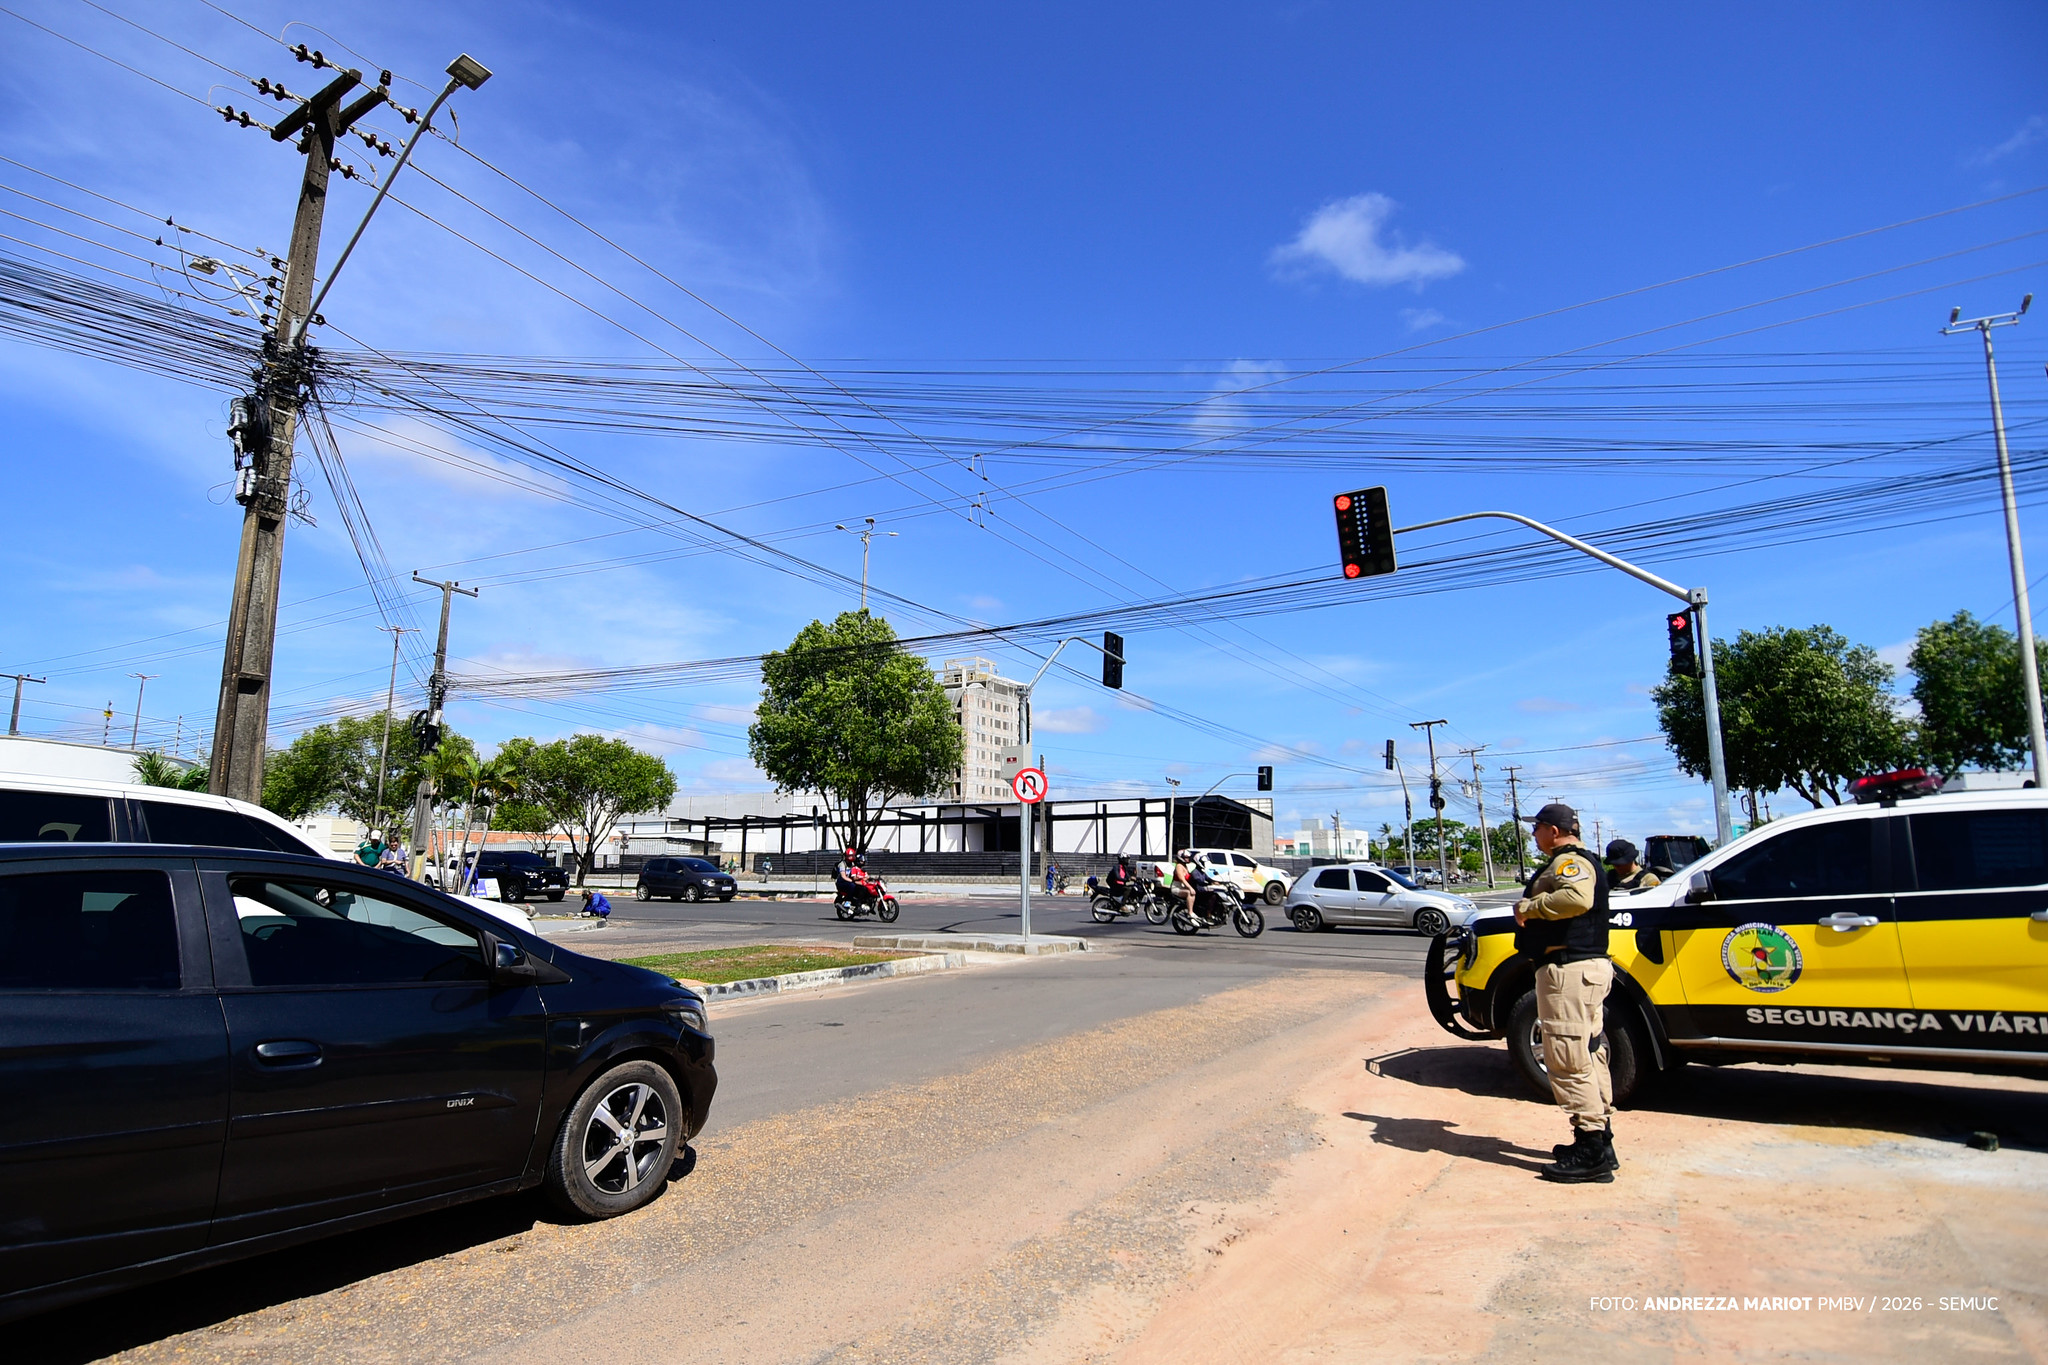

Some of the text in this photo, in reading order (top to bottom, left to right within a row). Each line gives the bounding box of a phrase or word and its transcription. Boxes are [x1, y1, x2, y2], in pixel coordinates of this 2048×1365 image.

[1739, 929, 1774, 938] SMTRAN
[1734, 922, 1774, 933] MUNICIPAL
[1774, 927, 1785, 936] DE
[1784, 934, 1797, 949] BOA
[1794, 949, 1802, 969] VISTA
[1746, 1008, 2048, 1035] SEGURANÇA VIÁRI
[446, 1097, 475, 1108] ONIX
